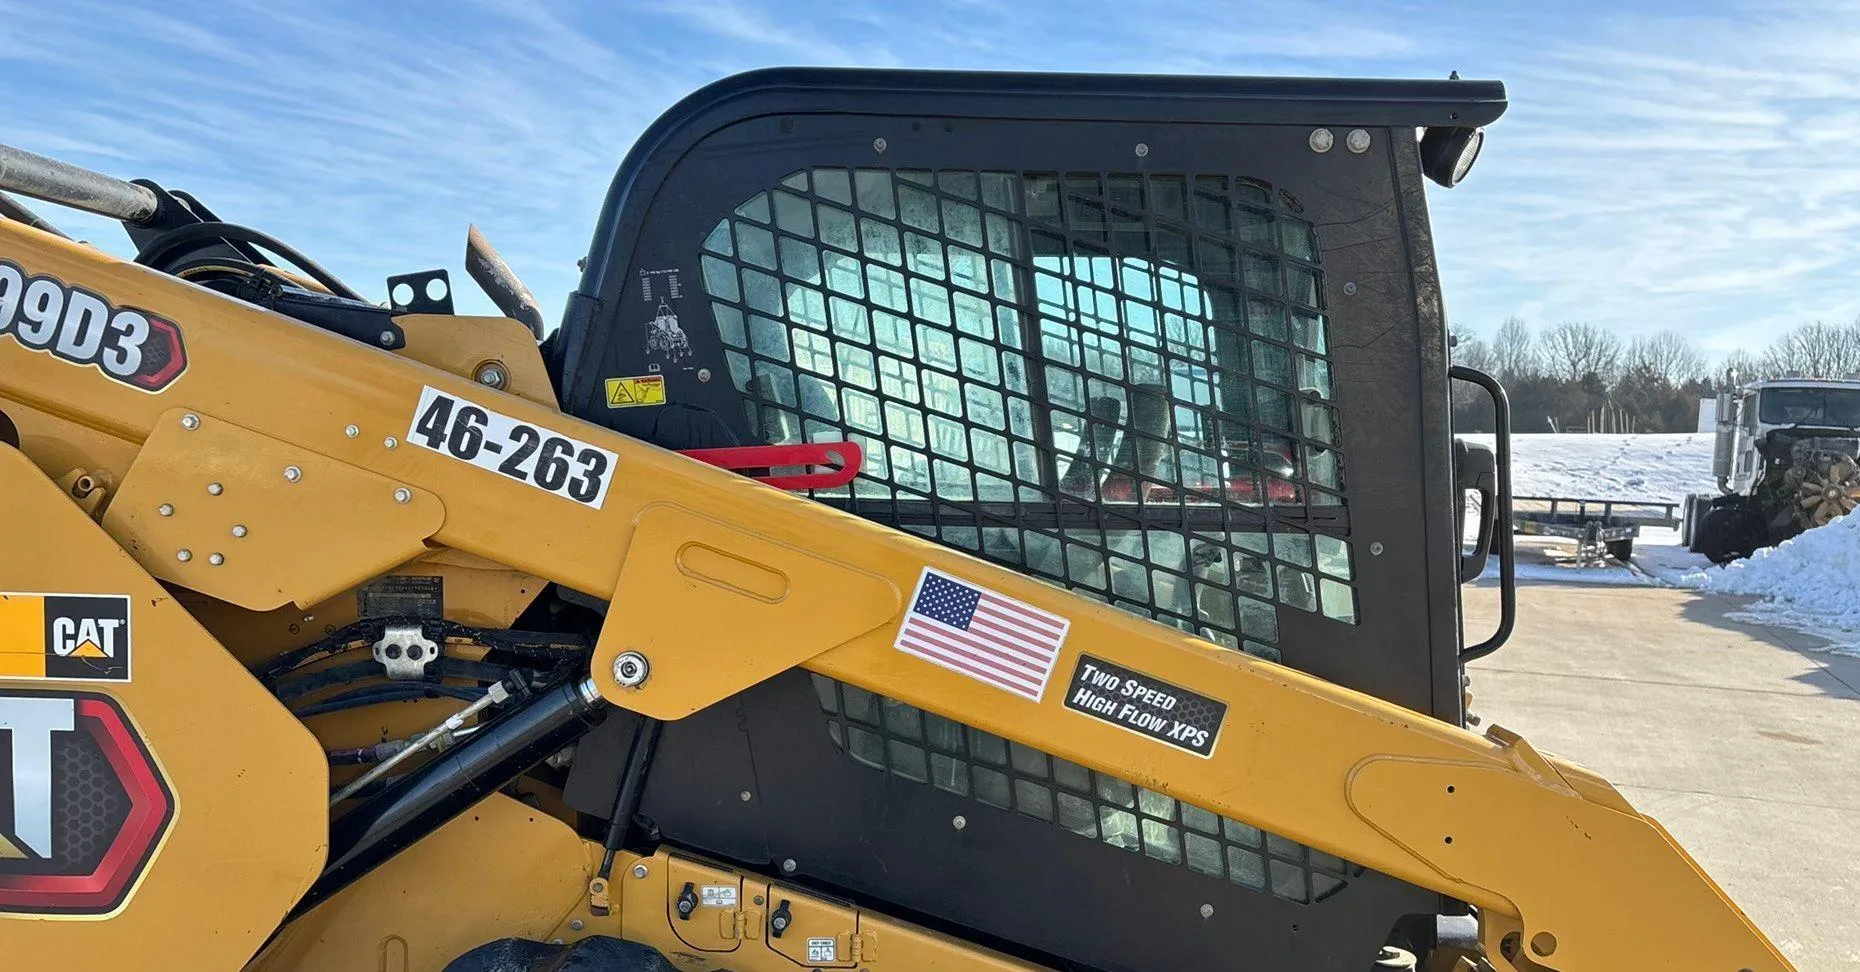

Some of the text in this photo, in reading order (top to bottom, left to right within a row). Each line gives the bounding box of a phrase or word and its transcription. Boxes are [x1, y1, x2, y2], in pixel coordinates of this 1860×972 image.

[415, 395, 608, 503] 46-263
[53, 616, 119, 658] CAT
[1080, 664, 1177, 711] TWO SPEED
[1072, 687, 1210, 748] HIGH FLOW XPS
